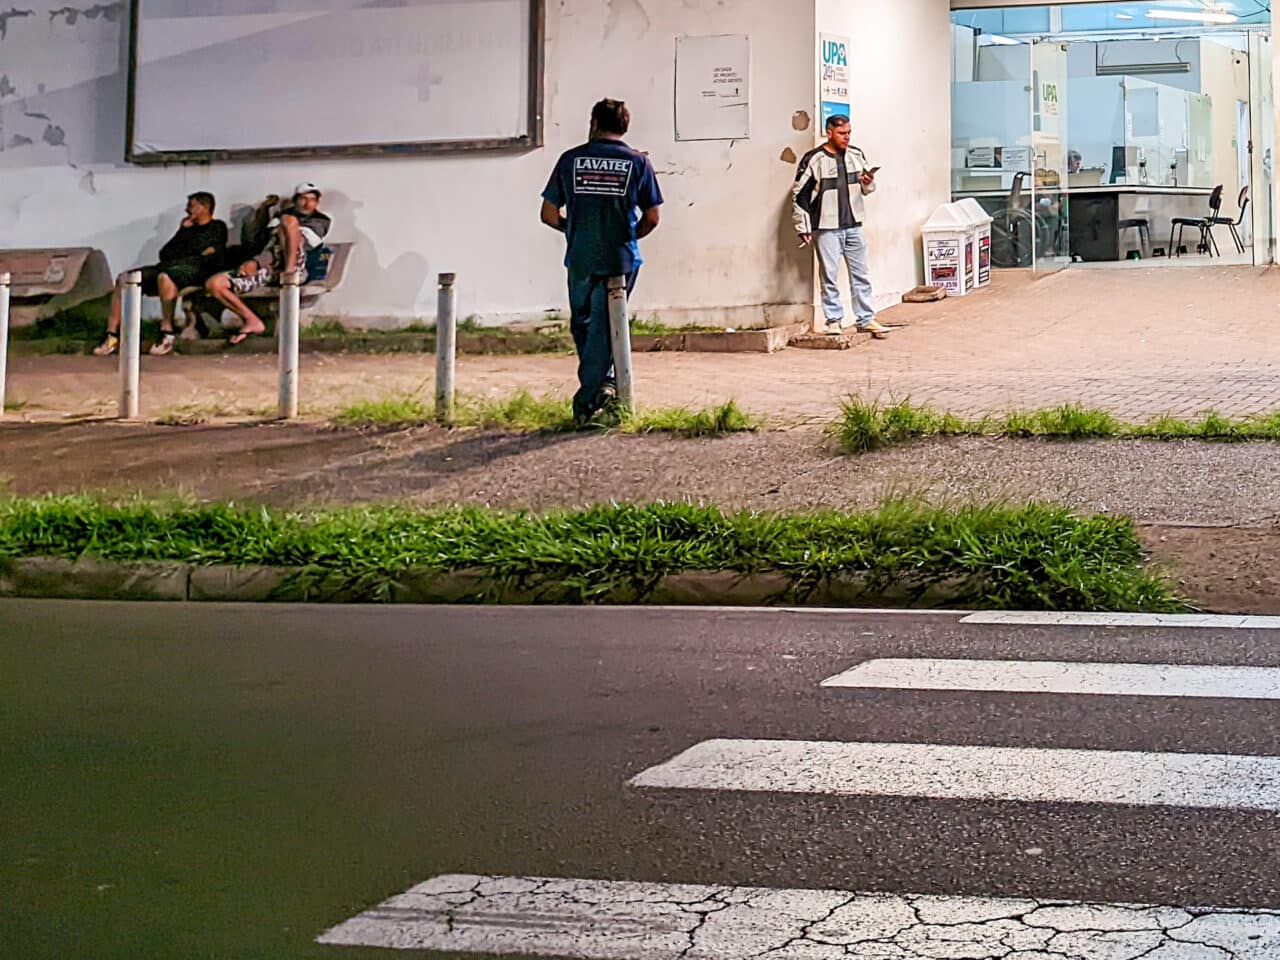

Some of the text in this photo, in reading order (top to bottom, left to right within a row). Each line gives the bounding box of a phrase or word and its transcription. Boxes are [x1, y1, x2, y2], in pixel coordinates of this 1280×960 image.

[823, 40, 847, 66] UPA
[1042, 83, 1057, 102] UPA
[576, 159, 630, 172] LAVATEC
